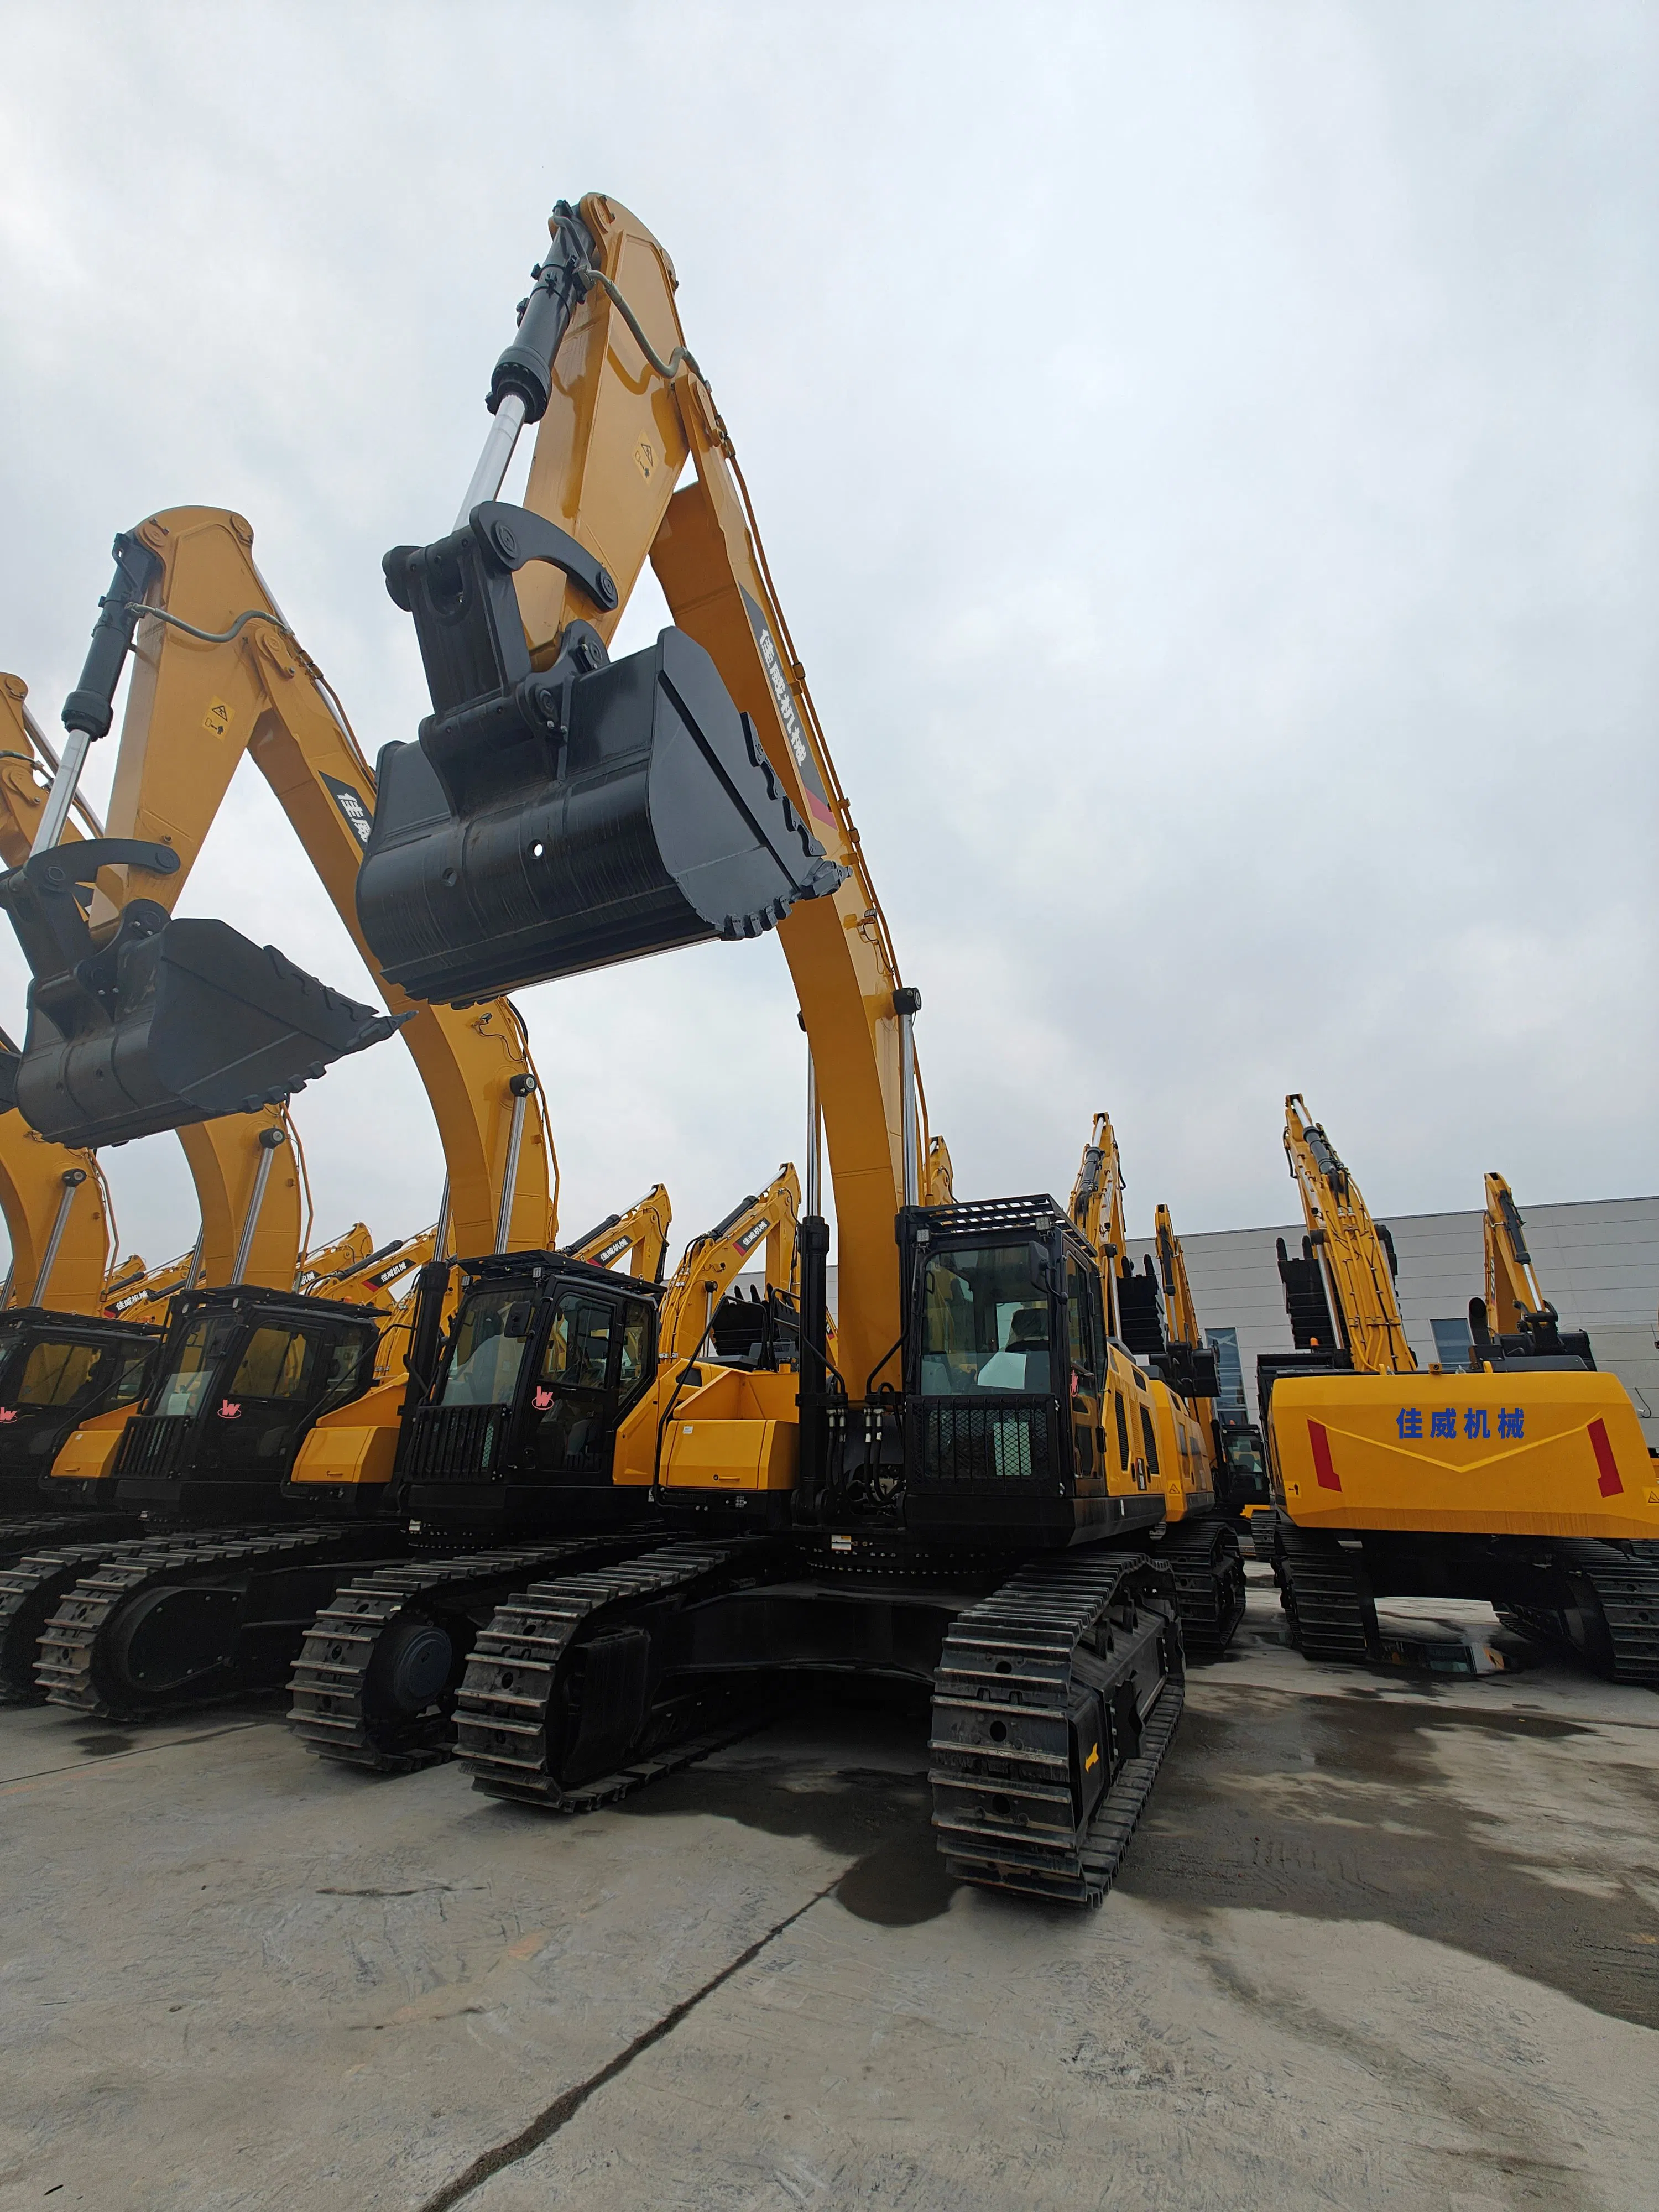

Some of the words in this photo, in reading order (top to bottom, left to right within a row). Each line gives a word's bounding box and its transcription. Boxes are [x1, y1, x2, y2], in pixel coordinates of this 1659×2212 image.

[759, 628, 807, 767] 佳威机械
[742, 1220, 768, 1246] 佳威机械
[600, 1238, 628, 1261] 佳威机械
[380, 1261, 406, 1282] 佳威机械
[1396, 1408, 1524, 1439] 佳威机械
